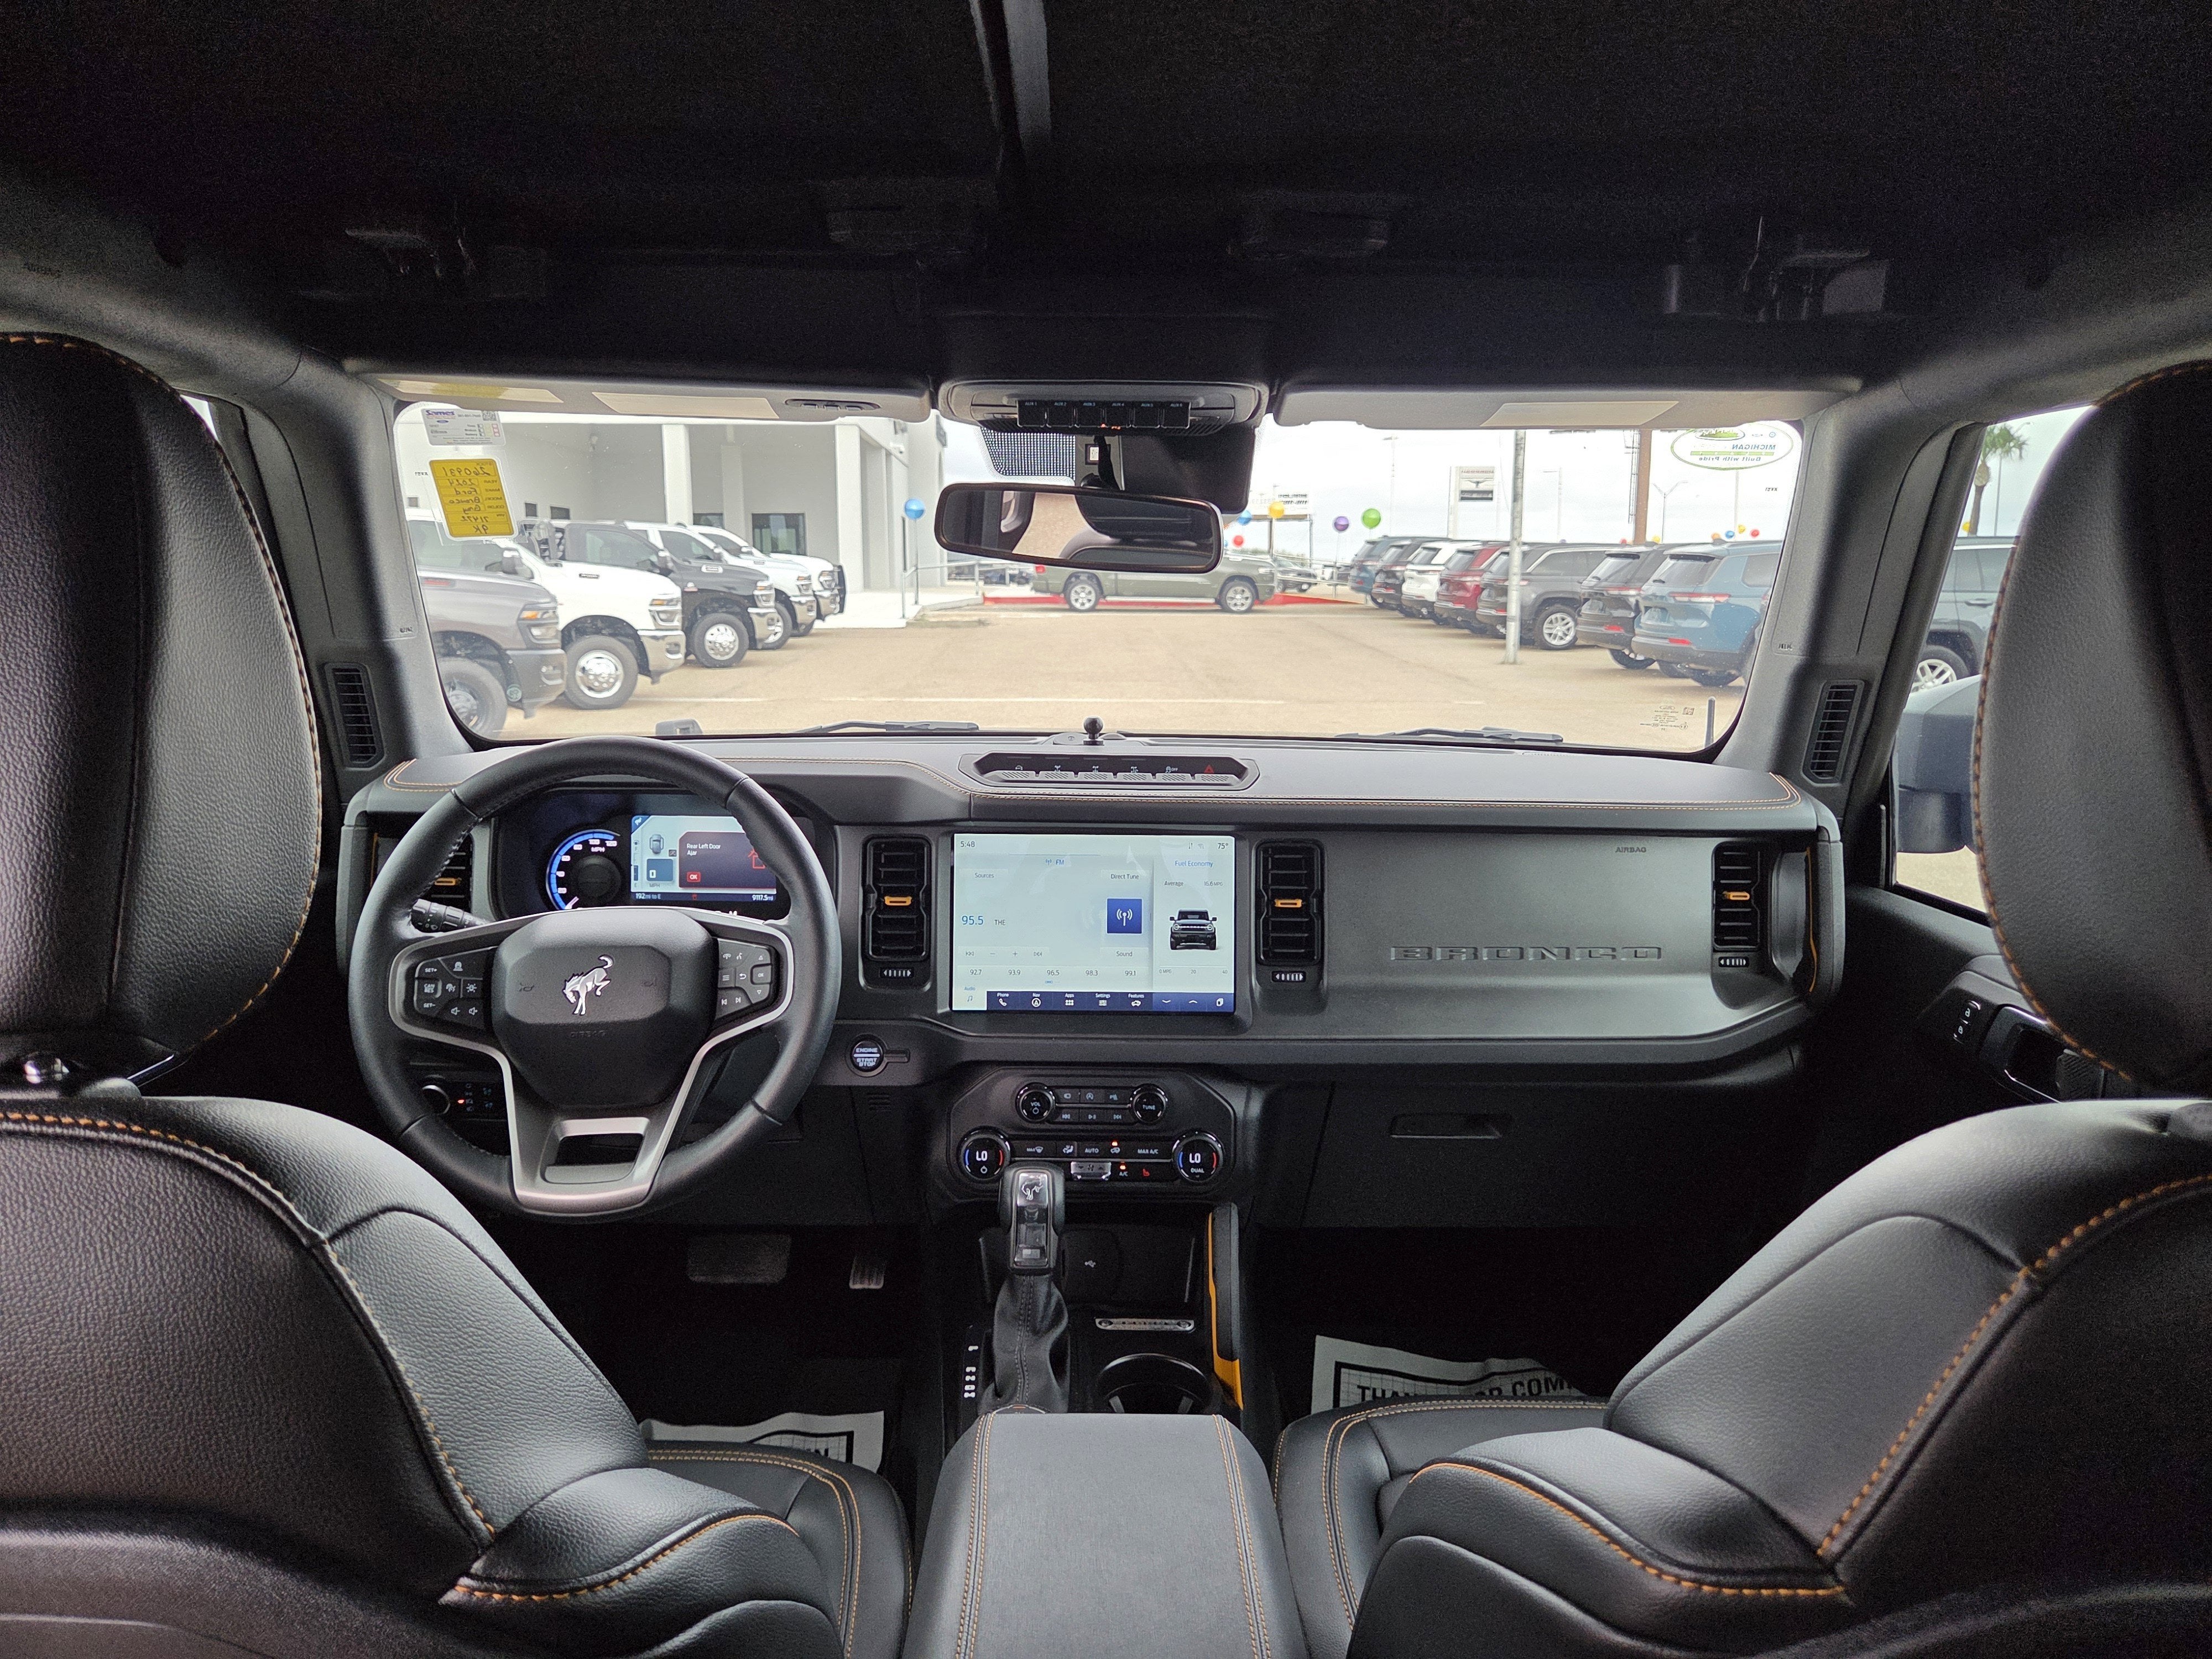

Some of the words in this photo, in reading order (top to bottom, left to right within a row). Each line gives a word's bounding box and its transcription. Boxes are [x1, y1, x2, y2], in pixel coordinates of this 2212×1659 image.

[962, 915, 984, 925] 95.5
[1391, 946, 1661, 961] BRONCO
[976, 1150, 988, 1161] LO
[1190, 1153, 1201, 1164] LO
